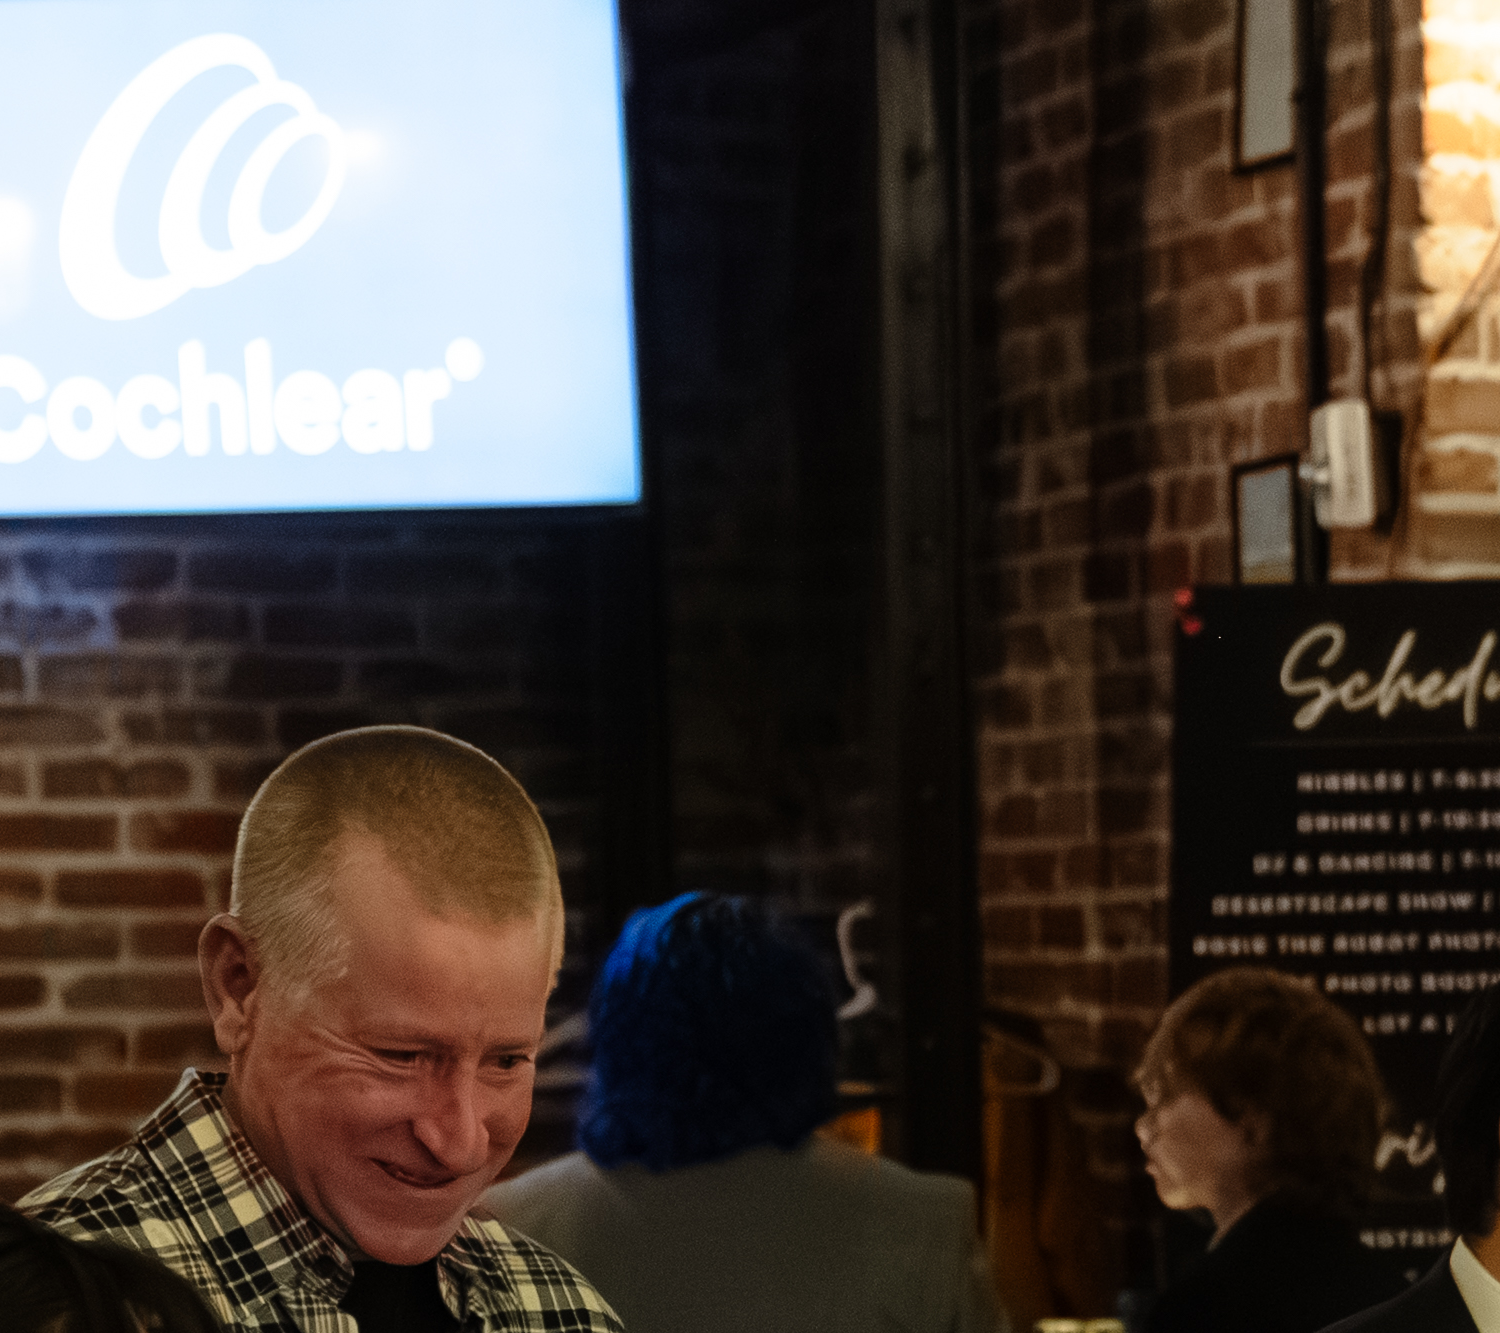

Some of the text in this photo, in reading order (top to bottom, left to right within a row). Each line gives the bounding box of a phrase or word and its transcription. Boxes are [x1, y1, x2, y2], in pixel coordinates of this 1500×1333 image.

[1296, 812, 1393, 835] DRINKS
[1317, 851, 1435, 874] DANCING
[1397, 891, 1476, 913] SHOW
[1192, 935, 1269, 957] ROSIE
[1277, 934, 1326, 956] THE
[1332, 932, 1421, 954] ROBOT
[1324, 973, 1414, 995] PHOTO
